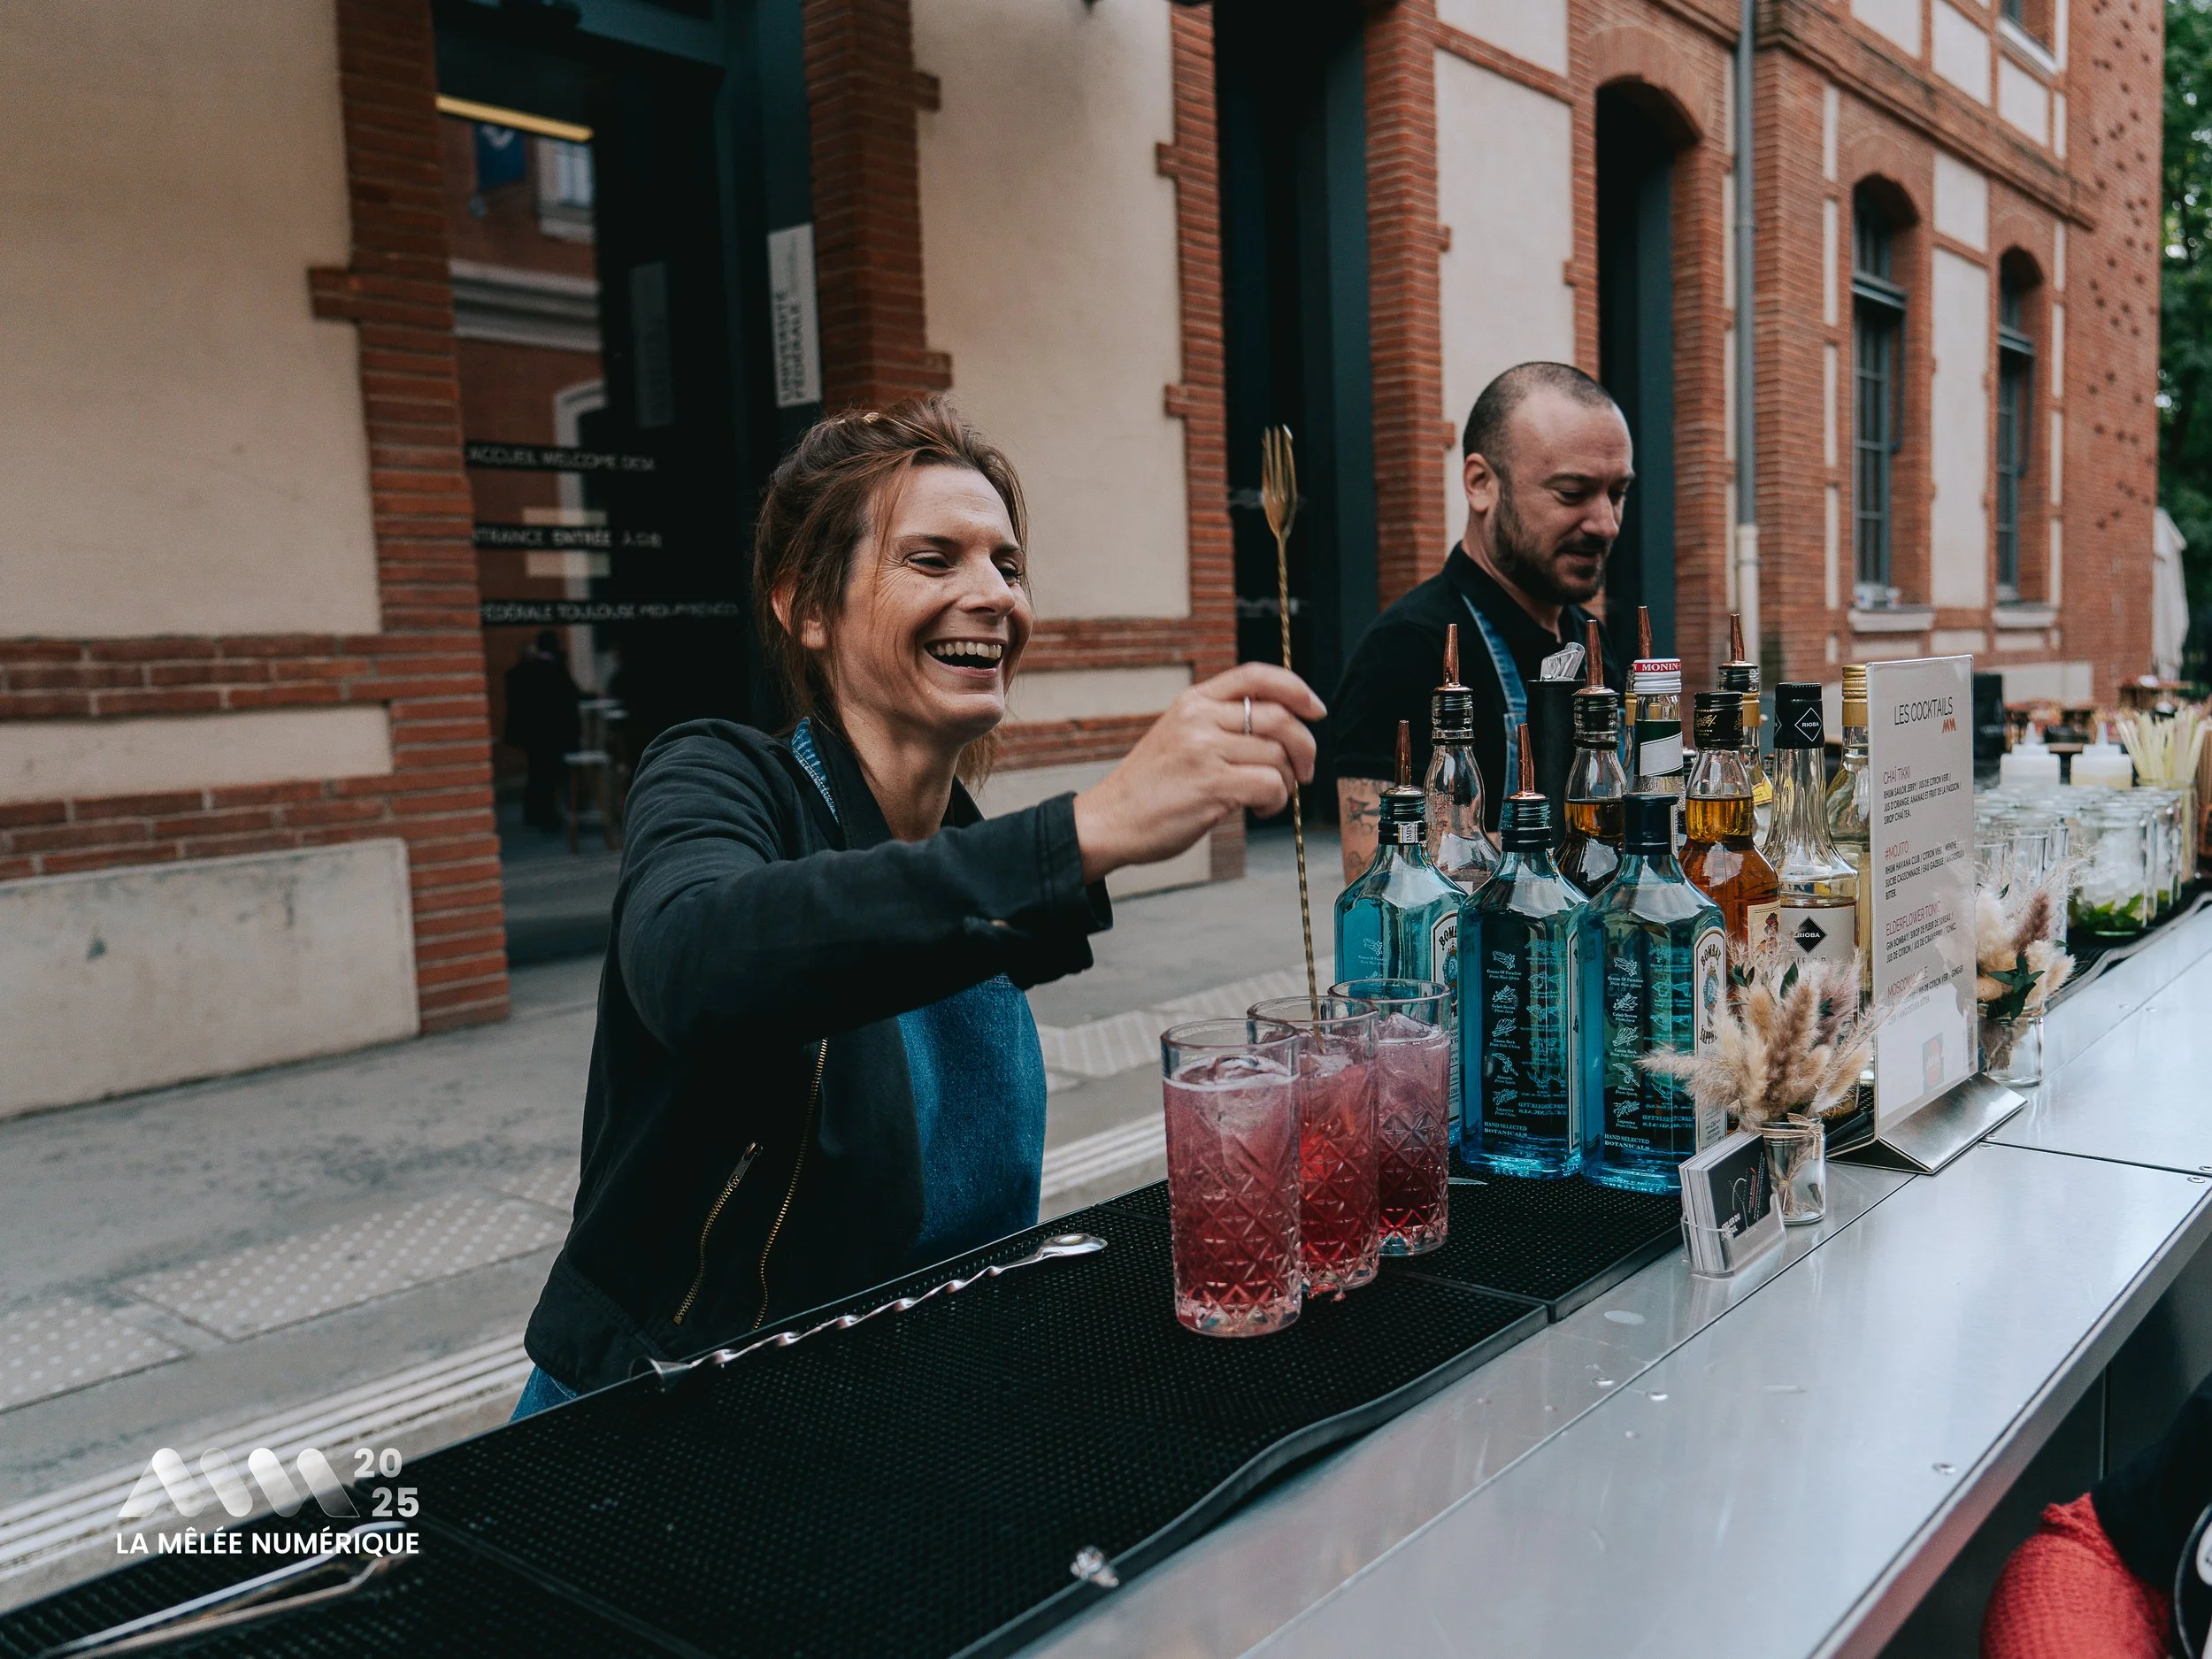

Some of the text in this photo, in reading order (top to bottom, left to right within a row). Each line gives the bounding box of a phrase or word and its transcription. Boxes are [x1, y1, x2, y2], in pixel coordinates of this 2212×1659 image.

[467, 447, 536, 465] ACCUEIL
[542, 449, 617, 469] WELCOME
[557, 603, 634, 619] TOULOUSE
[1894, 696, 1954, 726] LES COCKTAILS
[1894, 785, 1907, 796] SAILOR
[1930, 776, 1941, 786] CITRON
[1910, 792, 1924, 803] ANANAS
[1946, 782, 1960, 793] PASSION
[1884, 814, 1893, 825] SIROP
[1885, 841, 1909, 861] #MOJITO
[1895, 859, 1911, 871] HAVANA
[1911, 854, 1920, 864] CLUB
[1923, 850, 1935, 861] CITRON
[1886, 876, 1897, 887] SUCRE
[1886, 907, 1924, 936] ELDERFLOWER
[1893, 933, 1909, 947] BOMBAY
[1910, 927, 1919, 939] SIROP
[1701, 943, 1722, 966] BOMBAY
[1898, 944, 1911, 956] CITRON
[1929, 978, 1941, 989] CITRON
[1951, 964, 1963, 977] GINGER
[1485, 1128, 1528, 1138] BOTANICALS
[1500, 1123, 1527, 1132] SELECTED
[1604, 1141, 1650, 1150] BOTANICALS
